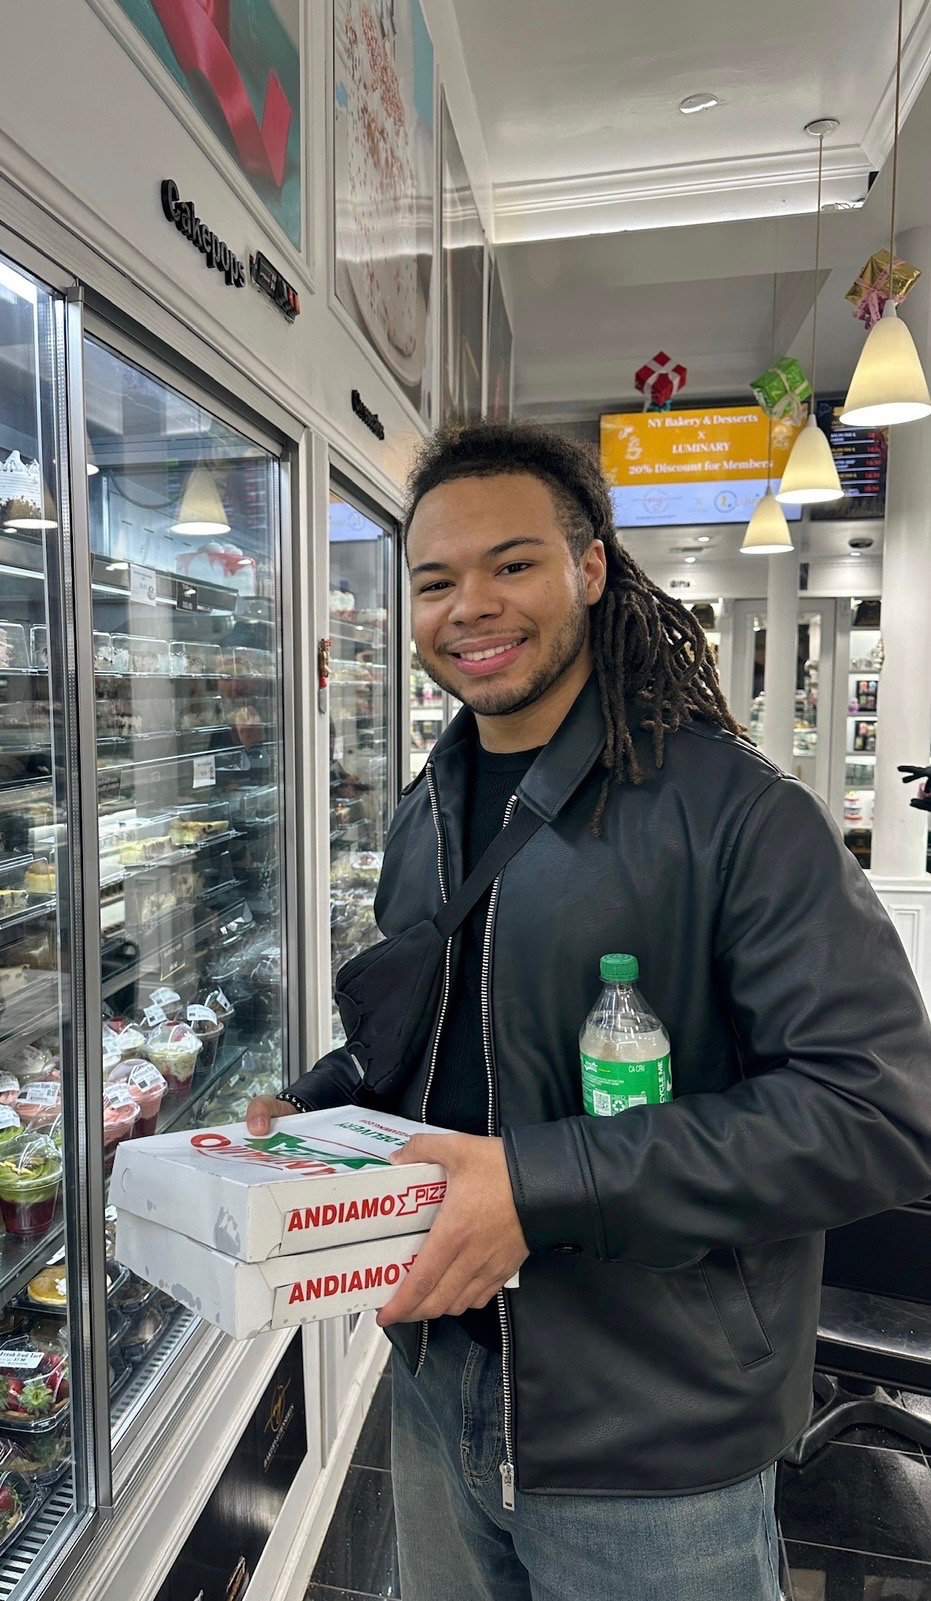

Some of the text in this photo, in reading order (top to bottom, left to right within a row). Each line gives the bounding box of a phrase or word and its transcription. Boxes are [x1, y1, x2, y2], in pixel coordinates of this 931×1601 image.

[161, 179, 246, 288] Cakepops
[647, 413, 759, 428] NY Bakery & Desserts
[672, 441, 731, 454] LUMINARY
[628, 464, 653, 475] 20%
[655, 461, 702, 473] Discount
[704, 460, 720, 471] for
[628, 1065, 645, 1073] CA CRV
[658, 1060, 663, 1075] ME
[335, 1121, 401, 1144] DELIVERY
[415, 1184, 447, 1203] PIZZ
[288, 1193, 396, 1232] ANDIAMO
[288, 1262, 400, 1304] ANDIAMO
